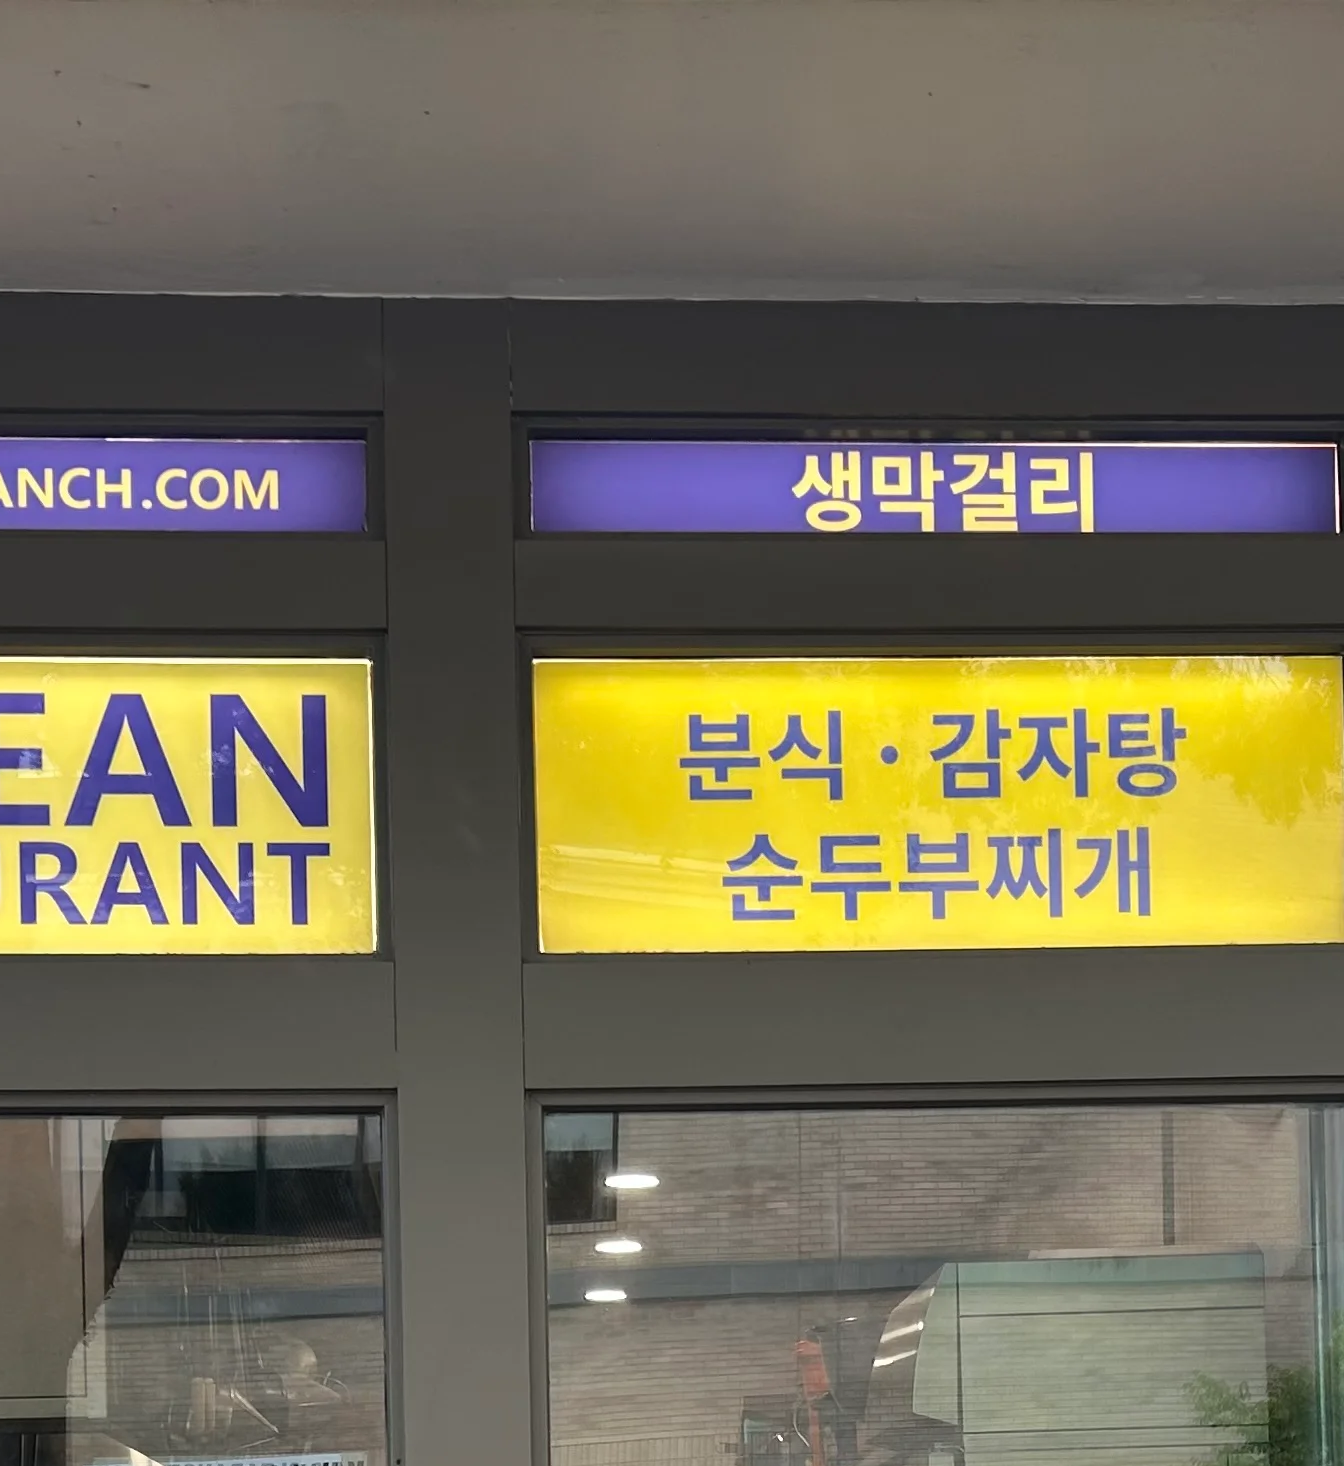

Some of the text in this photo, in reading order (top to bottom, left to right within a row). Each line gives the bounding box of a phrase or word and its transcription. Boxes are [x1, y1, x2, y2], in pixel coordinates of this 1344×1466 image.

[792, 451, 1094, 533] 생막걸리
[679, 712, 846, 801] 분식
[930, 709, 1187, 798] 감자탕
[722, 828, 1152, 921] 순두부찌개
